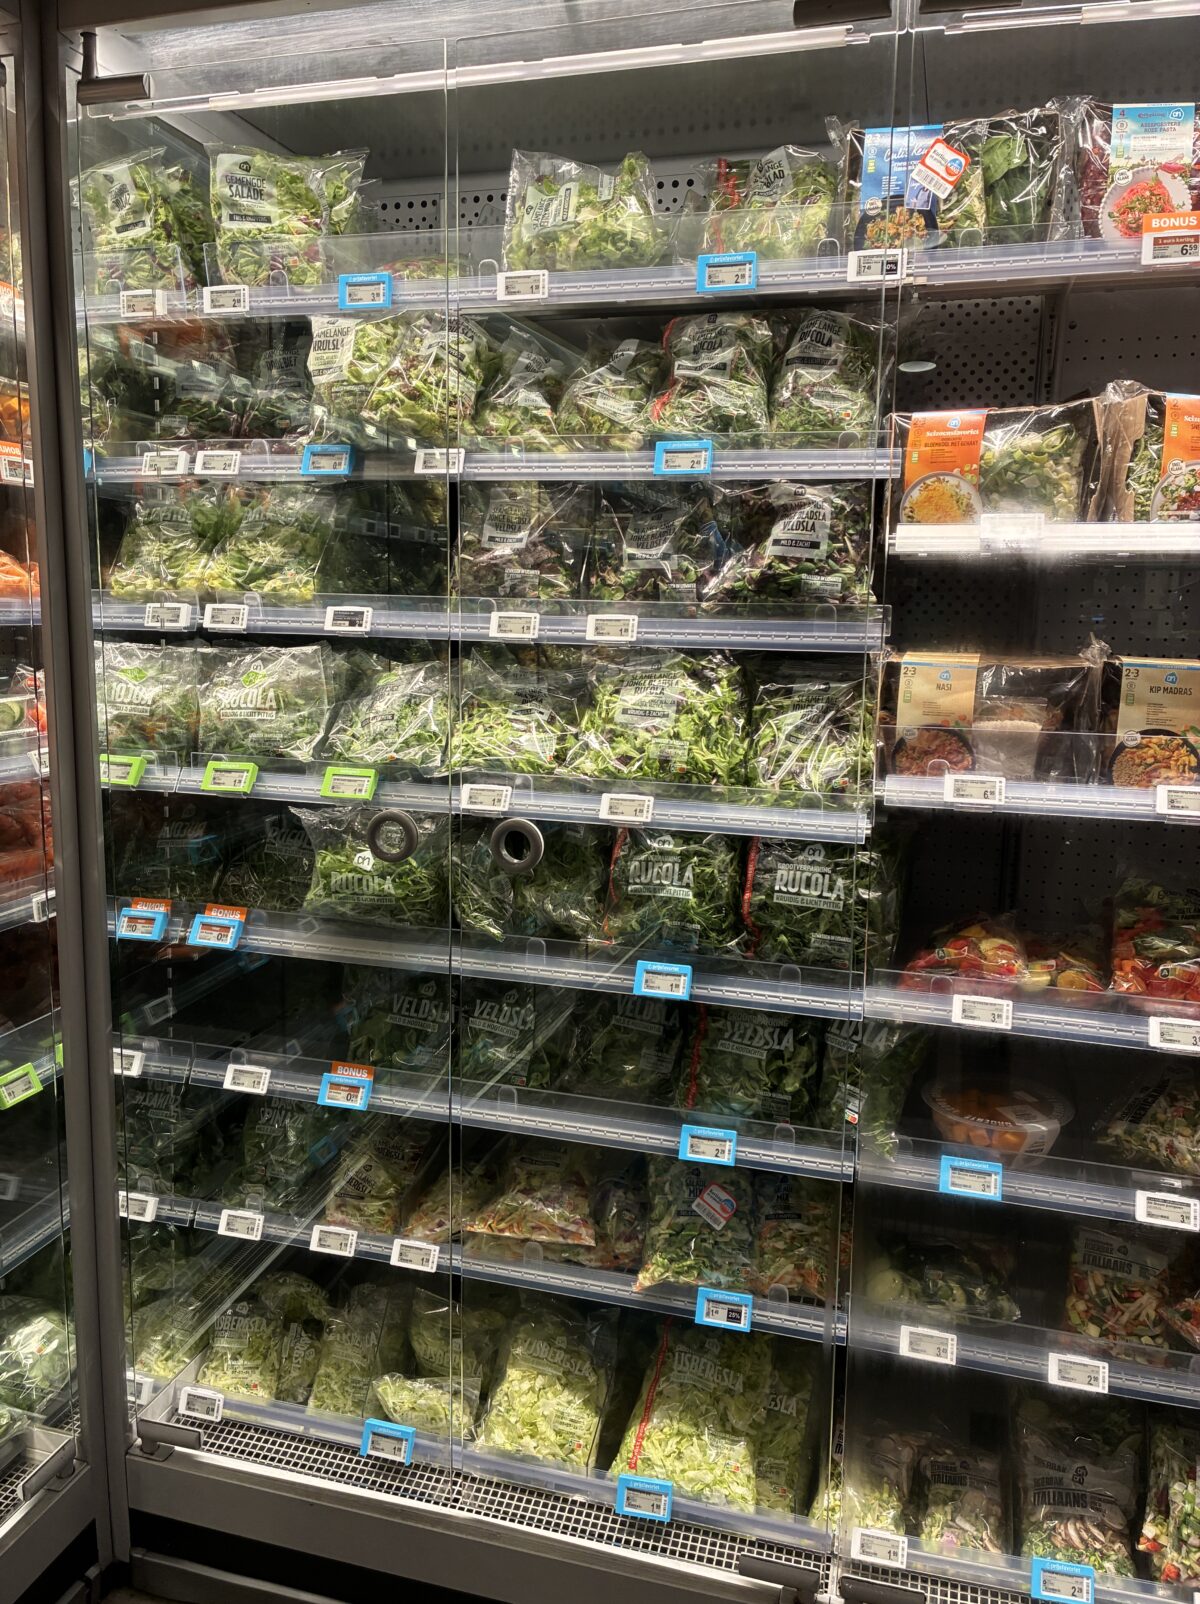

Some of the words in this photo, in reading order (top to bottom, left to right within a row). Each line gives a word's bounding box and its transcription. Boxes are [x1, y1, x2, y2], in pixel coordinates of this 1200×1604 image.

[229, 185, 265, 202] SALADE
[1151, 216, 1198, 228] BONUS
[798, 330, 833, 347] RUCOLA
[782, 520, 816, 533] VELDSLA
[1125, 668, 1140, 678] 2-3
[935, 683, 952, 692] NASI
[1149, 685, 1162, 694] KIP
[1162, 685, 1193, 696] MADRAS
[628, 861, 695, 886] RUCOLA
[329, 871, 396, 895] RUCOLA
[774, 869, 846, 900] RUCOLA
[806, 897, 822, 907] LICHT
[822, 899, 841, 910] PITTIG
[210, 907, 241, 919] BONUS
[472, 999, 536, 1031] VELDSLA
[723, 1020, 795, 1052] VELDSLA
[336, 1065, 369, 1078] BONUS
[728, 1310, 741, 1319] 25%
